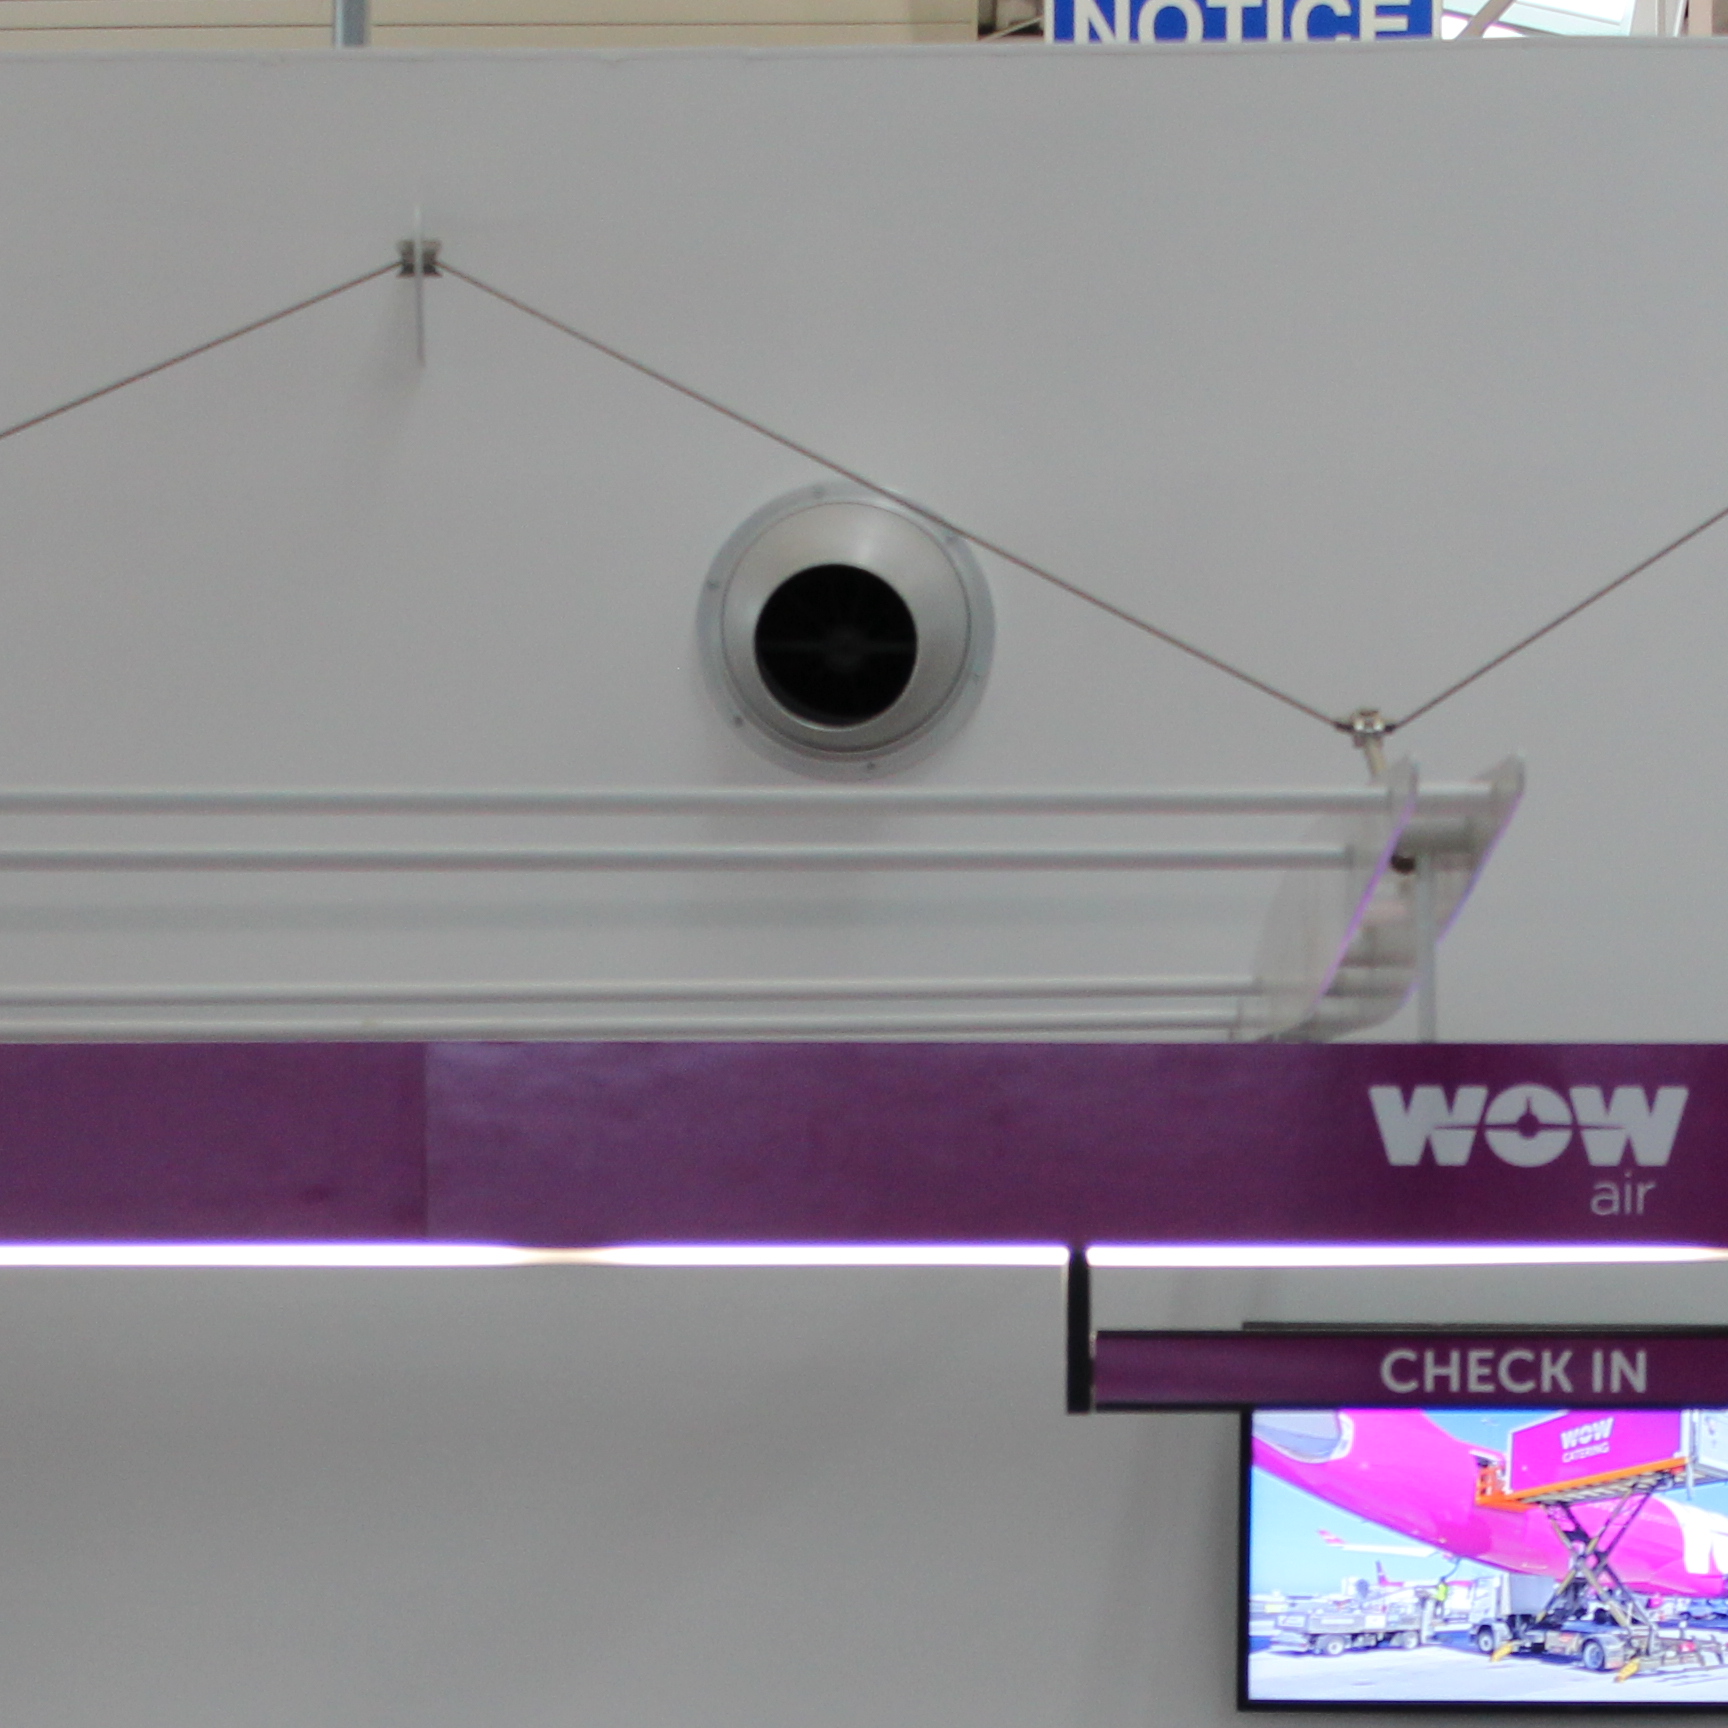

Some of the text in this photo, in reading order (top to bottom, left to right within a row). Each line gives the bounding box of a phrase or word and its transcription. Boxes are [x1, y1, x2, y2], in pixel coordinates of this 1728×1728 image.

[1368, 1084, 1689, 1168] WOW
[1589, 1170, 1656, 1216] air
[1380, 1349, 1647, 1394] CHECK IN
[1559, 1417, 1614, 1450] WOW
